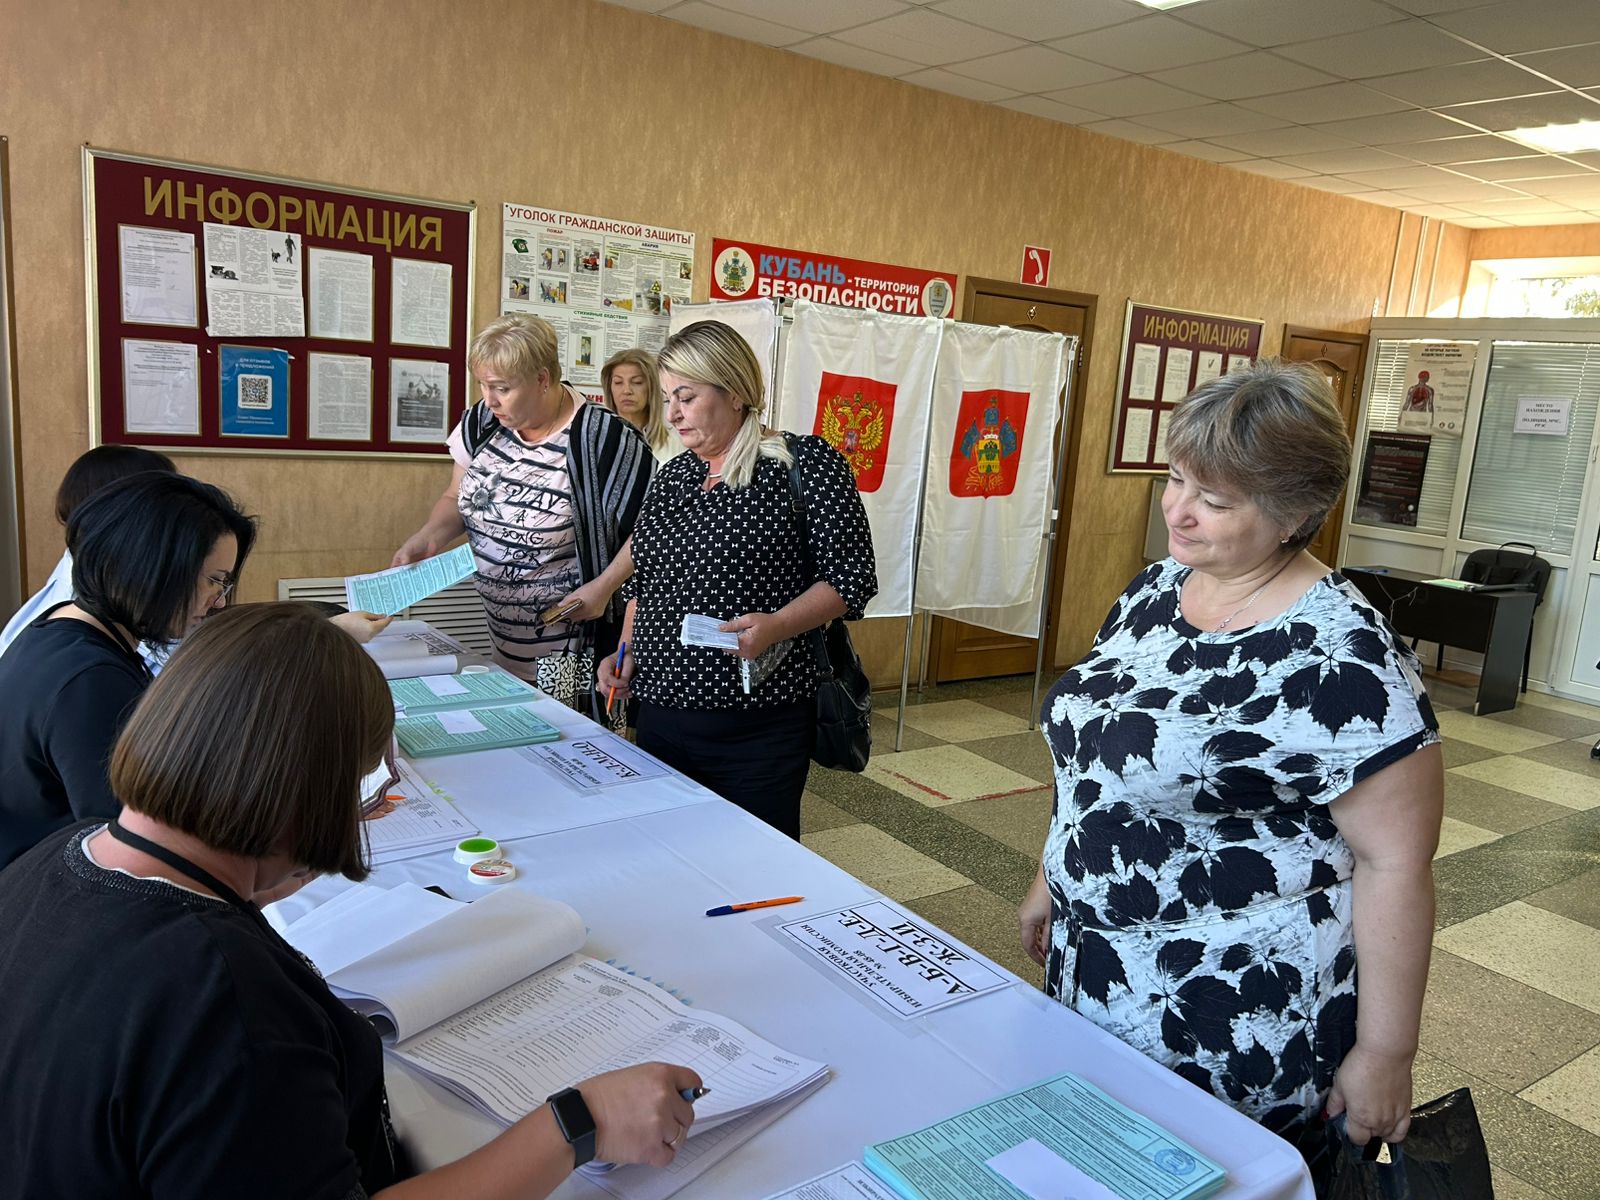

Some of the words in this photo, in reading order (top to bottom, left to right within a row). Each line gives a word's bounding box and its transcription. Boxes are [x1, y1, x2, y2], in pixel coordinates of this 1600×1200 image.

[144, 176, 442, 252] ИНФОРМАЦИЯ
[509, 207, 556, 223] УГОЛОК
[559, 215, 642, 236] ГРАЖДАНСКОЙ
[644, 228, 691, 244] ЗАЩИТЫ
[759, 254, 846, 285] КУБАНЬ
[854, 276, 920, 296] ТЕРРИТОРИЯ
[757, 277, 919, 315] БЕЗОПАСНОСТИ
[1143, 315, 1250, 350] ИНФОРМАЦИЯ
[502, 528, 544, 545] SONG
[801, 924, 848, 956] КОМИССИЯ
[889, 922, 966, 966] Ж-З-И
[818, 945, 877, 988] УЧАСТКОВАЯ
[846, 954, 923, 1009] ИЗБИРАТЕЛЬНАЯ
